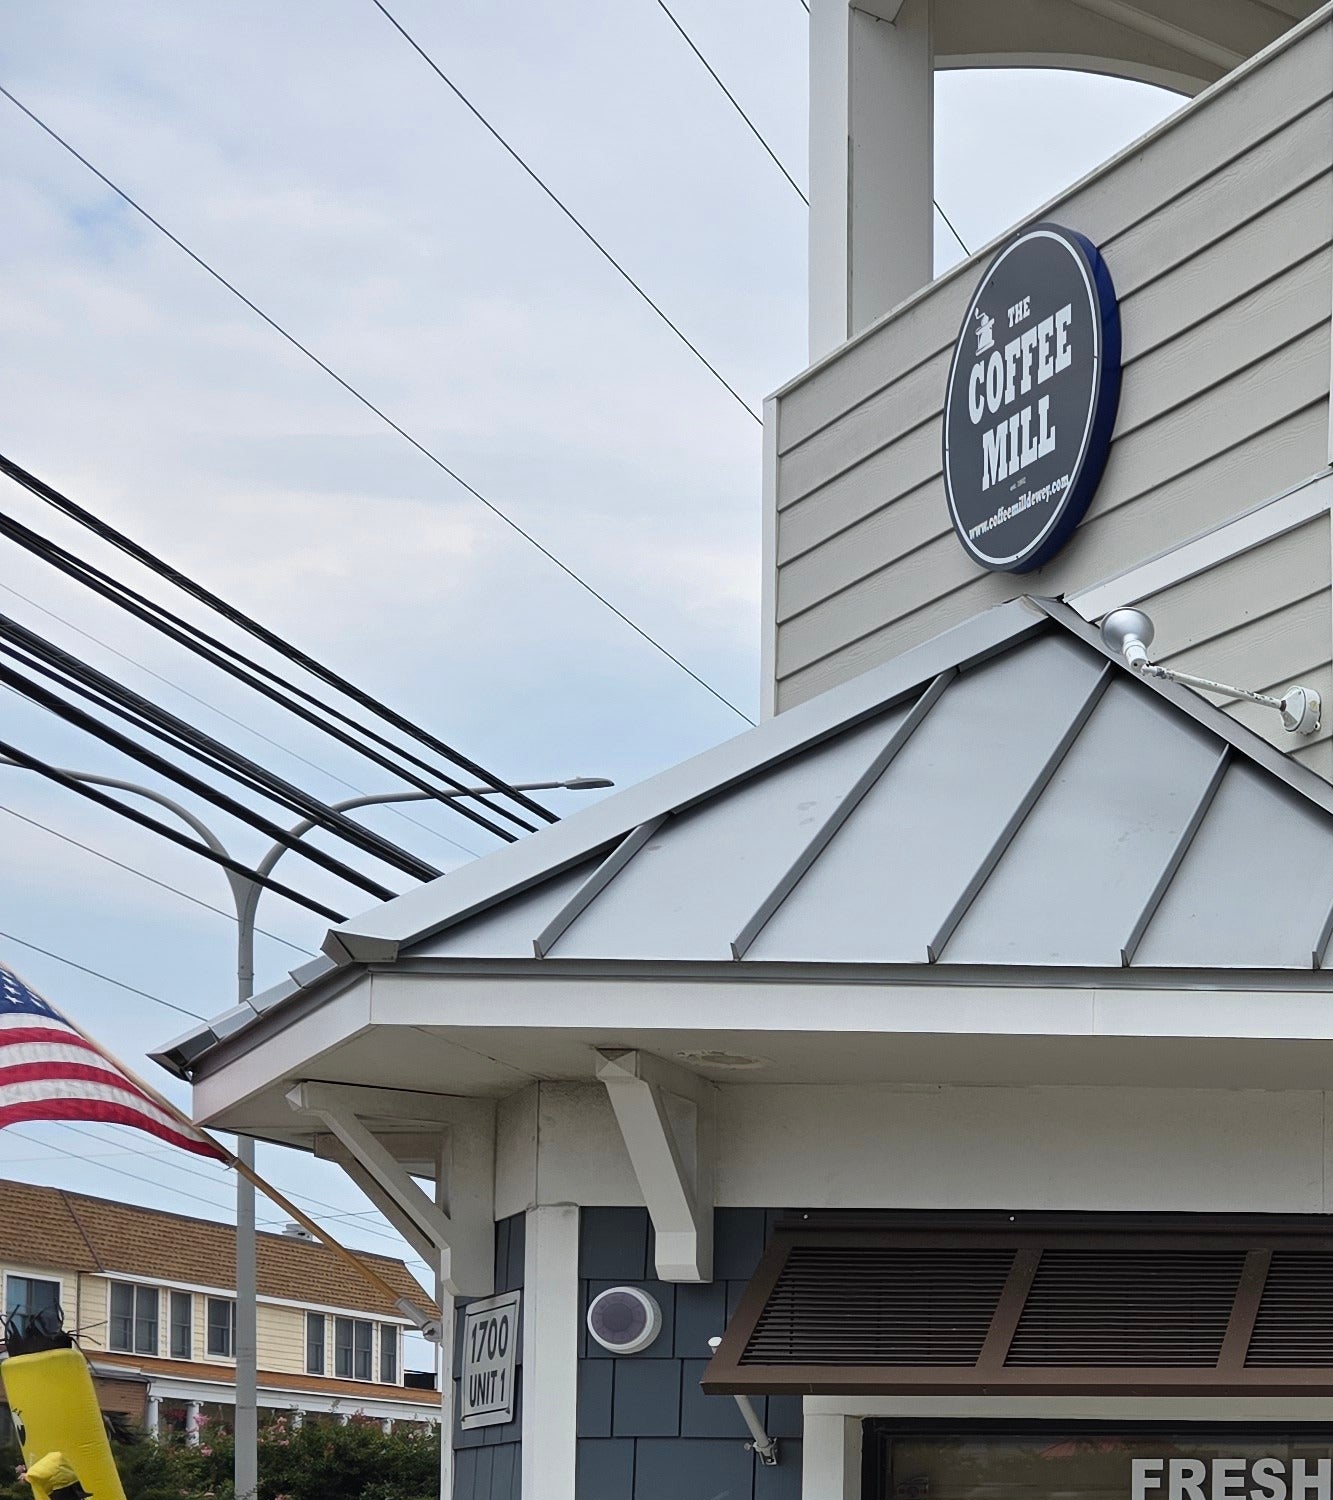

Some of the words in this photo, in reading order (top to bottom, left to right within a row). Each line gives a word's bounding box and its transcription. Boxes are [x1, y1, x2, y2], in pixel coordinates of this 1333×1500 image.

[1007, 296, 1031, 328] THE
[968, 304, 1073, 425] COFFEE
[982, 395, 1056, 491] MILL
[471, 1315, 508, 1363] 1700
[469, 1370, 498, 1408] UNIT
[500, 1368, 506, 1402] 1
